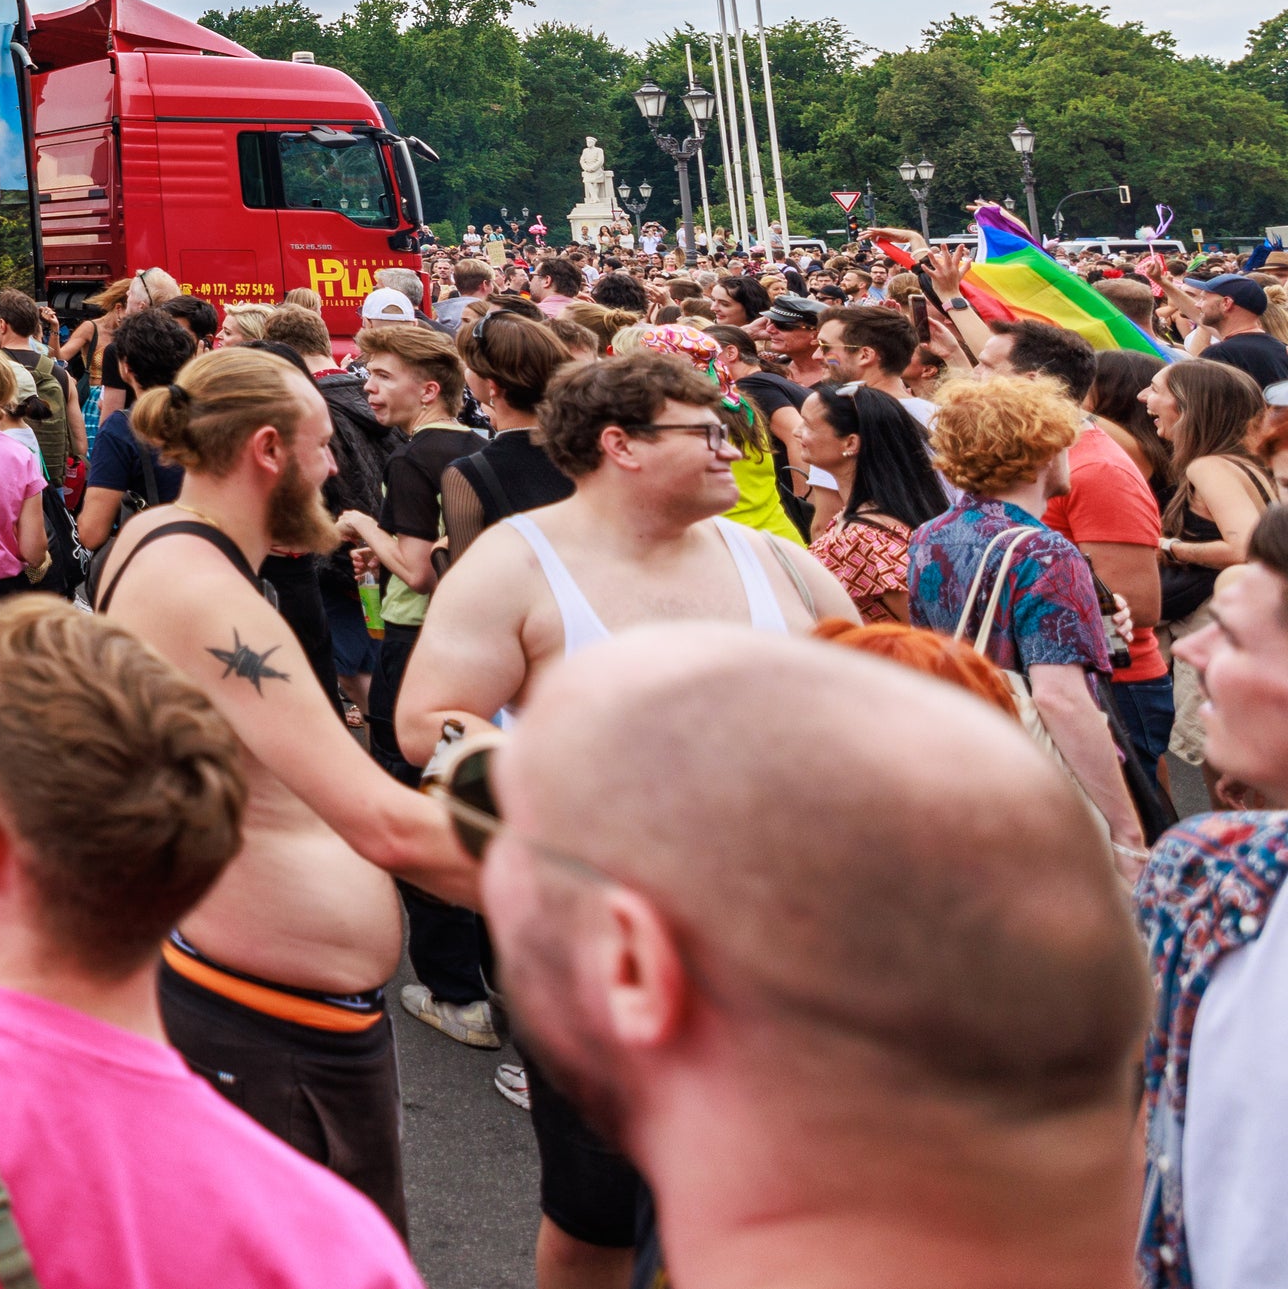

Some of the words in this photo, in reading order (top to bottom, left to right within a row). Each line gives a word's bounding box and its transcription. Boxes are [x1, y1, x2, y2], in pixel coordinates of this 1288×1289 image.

[195, 284, 211, 295] +49
[214, 284, 227, 295] 171
[235, 284, 250, 295] 557
[252, 284, 262, 295] 54
[264, 284, 274, 295] 26
[308, 258, 384, 297] HPLA
